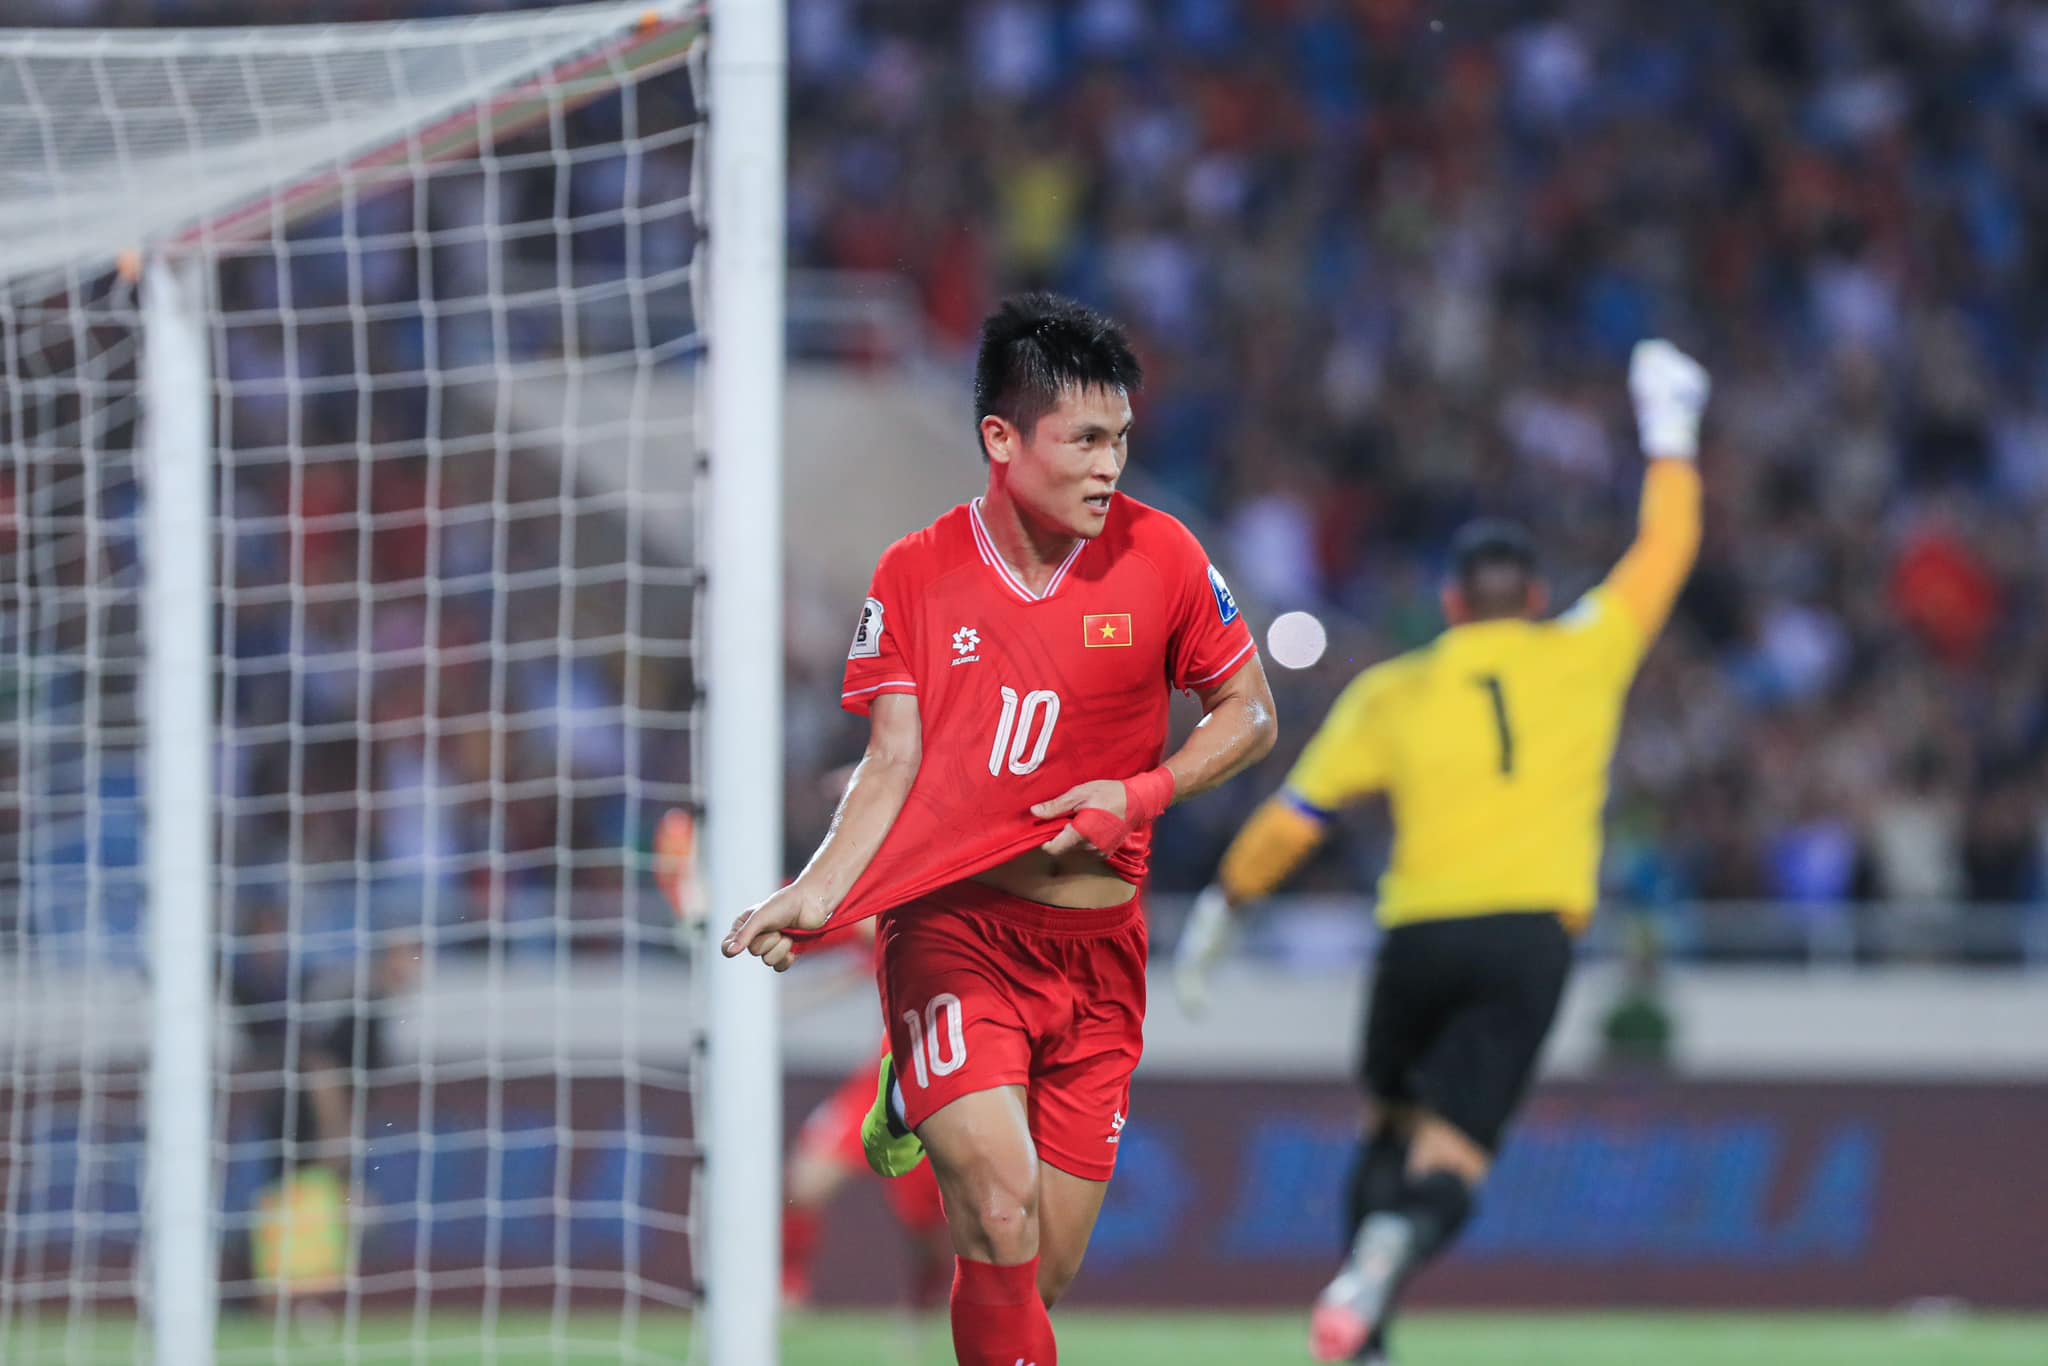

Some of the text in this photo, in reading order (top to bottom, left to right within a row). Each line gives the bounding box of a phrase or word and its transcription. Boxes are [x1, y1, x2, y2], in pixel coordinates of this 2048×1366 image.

[988, 685, 1060, 776] 10
[1471, 671, 1517, 778] 1
[903, 993, 967, 1089] 10
